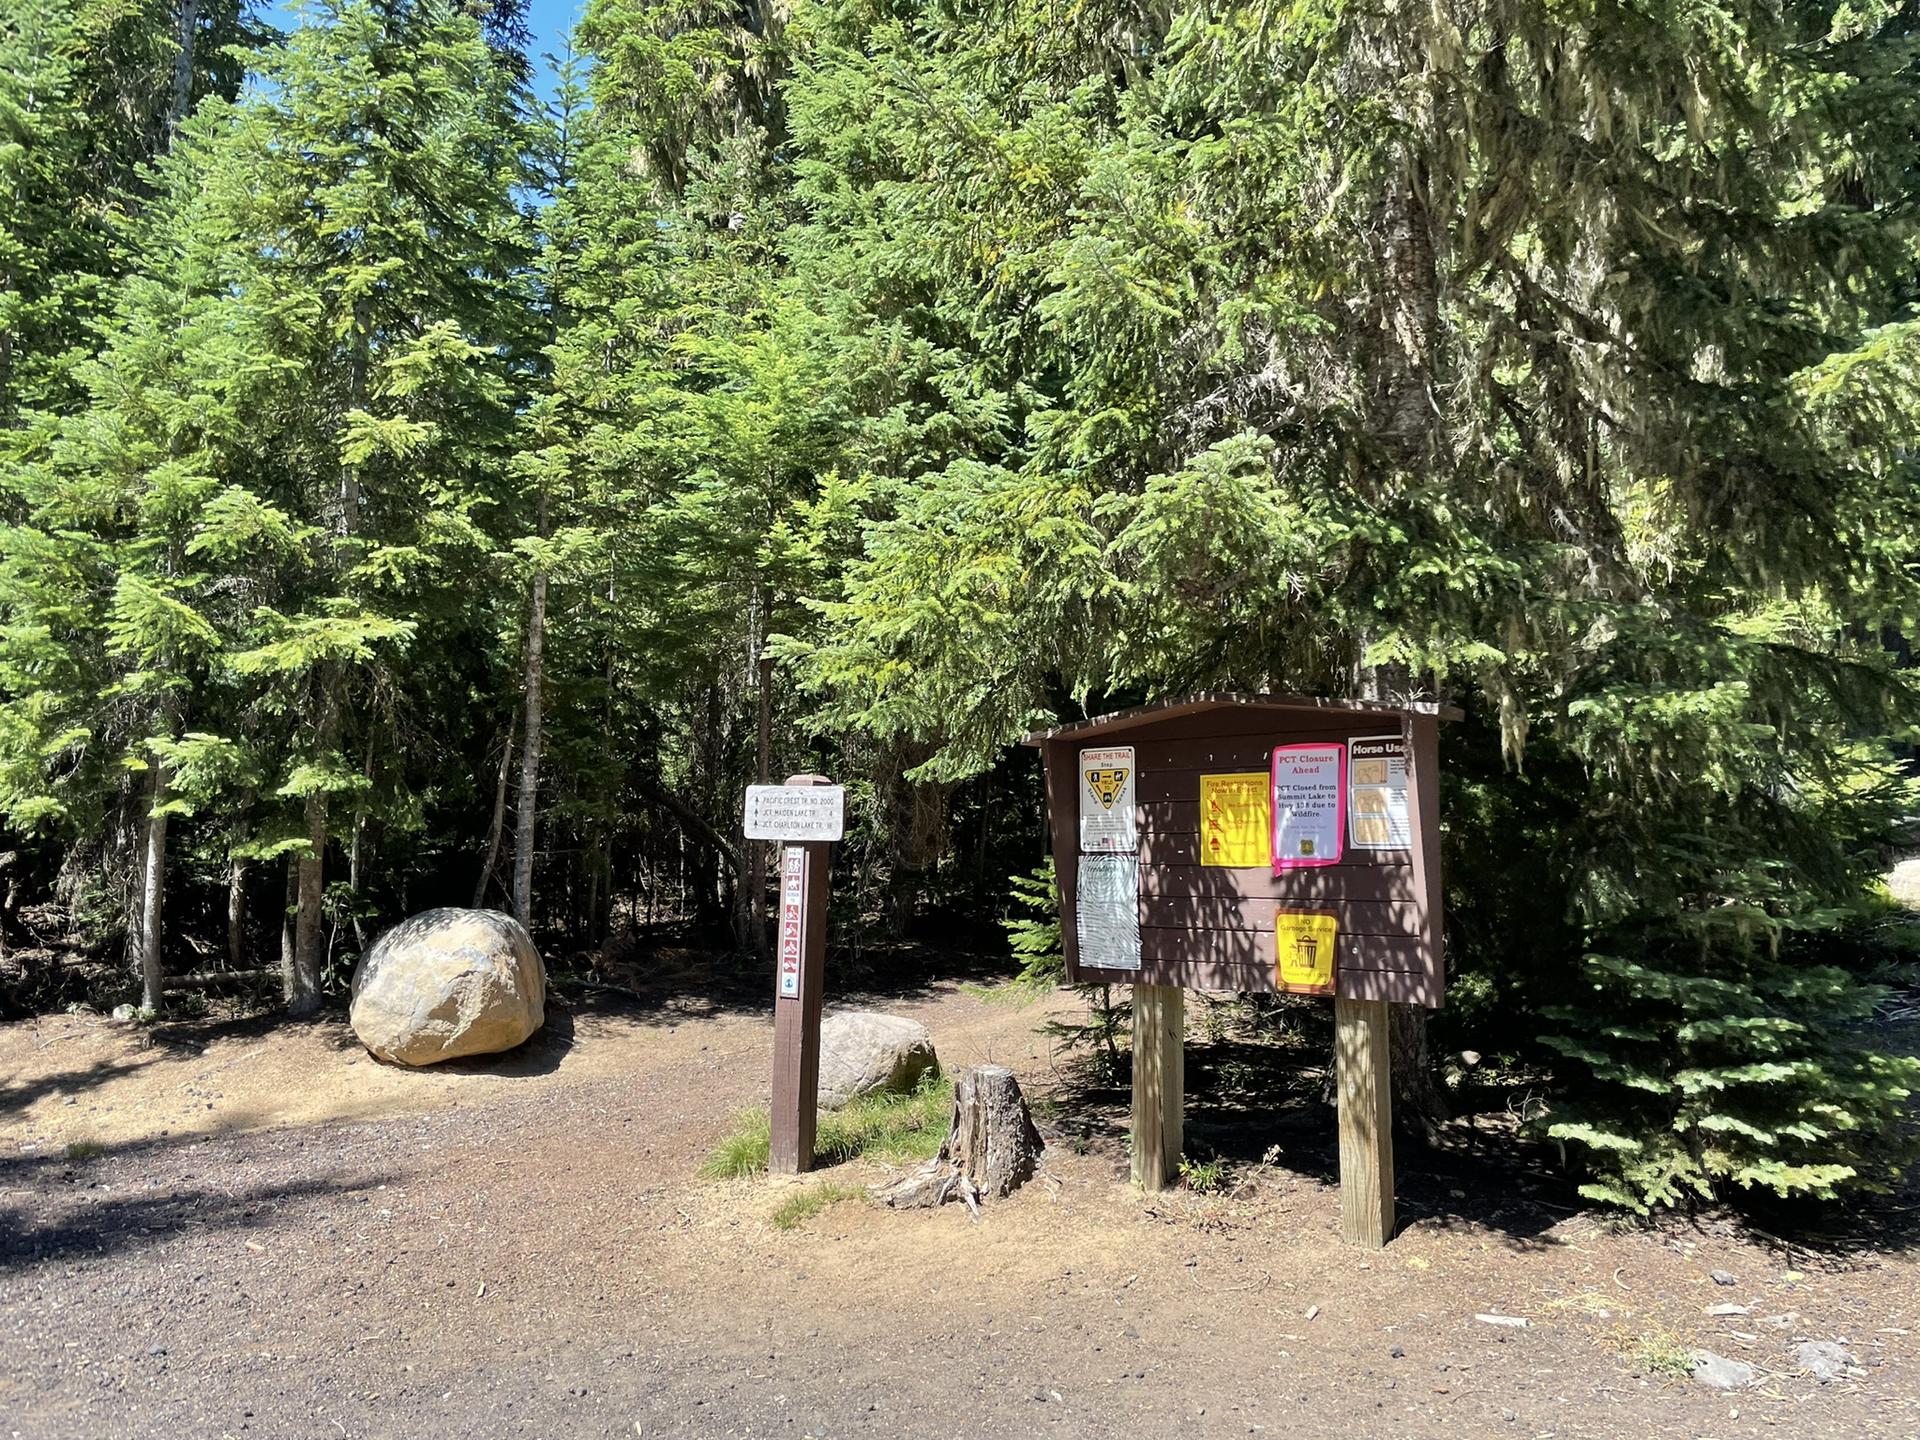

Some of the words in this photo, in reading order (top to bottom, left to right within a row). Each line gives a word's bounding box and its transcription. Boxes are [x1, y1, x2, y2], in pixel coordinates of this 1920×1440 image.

[1353, 744, 1384, 755] Horse
[1084, 752, 1102, 761] SHARE
[1103, 752, 1113, 760] THE
[1114, 751, 1130, 759] TRAIL
[1280, 756, 1296, 764] PCT
[1299, 755, 1334, 763] Closure
[1292, 766, 1320, 774] Ahead
[1206, 780, 1220, 788] Fire
[1221, 779, 1263, 787] Restrictions
[1308, 792, 1326, 800] Lake
[1278, 802, 1293, 810] Hwy
[801, 821, 814, 829] LAKE
